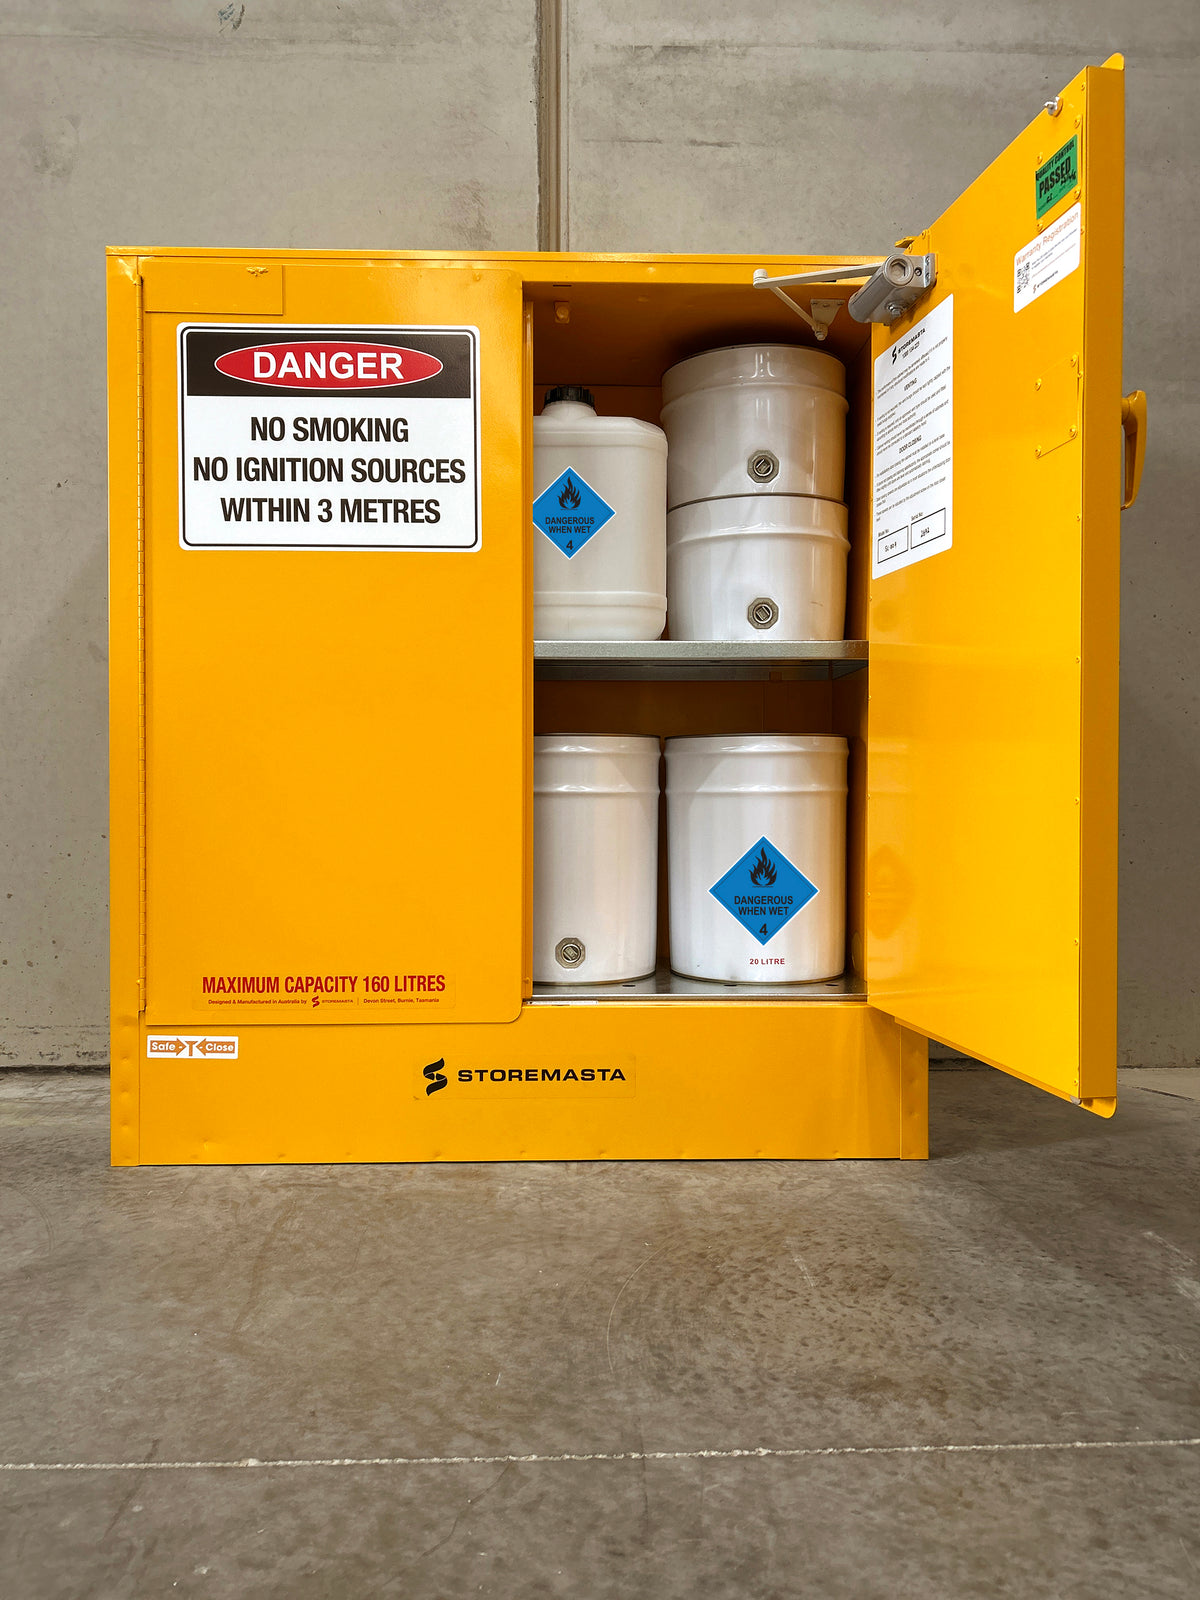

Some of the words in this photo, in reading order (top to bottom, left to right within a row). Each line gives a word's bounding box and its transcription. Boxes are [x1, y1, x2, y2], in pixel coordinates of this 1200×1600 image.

[1039, 156, 1071, 199] PASSED
[1016, 242, 1041, 266] Warranty
[1042, 212, 1078, 245] Registration
[898, 328, 926, 355] STOREMASTA
[253, 351, 405, 380] DANGER
[250, 416, 286, 441] NO
[292, 417, 409, 442] SMOKING
[193, 456, 228, 481] NO
[236, 457, 344, 482] IGNITION
[351, 458, 467, 484] SOURCES
[220, 497, 310, 523] WITHIN
[317, 498, 333, 523] 3
[340, 498, 441, 524] METRES
[545, 516, 595, 525] DANGEROUS
[548, 526, 572, 534] WHEN
[573, 526, 591, 534] WET
[566, 540, 574, 550] 4
[734, 895, 794, 905] DANGEROUS
[738, 906, 766, 916] WHEN
[768, 906, 789, 916] WET
[759, 923, 768, 936] 4
[202, 976, 280, 994] MAXIMUM
[284, 976, 359, 993] CAPACITY
[363, 976, 390, 993] 160
[394, 975, 446, 992] LITRES
[457, 1068, 626, 1083] STOREMASTA
